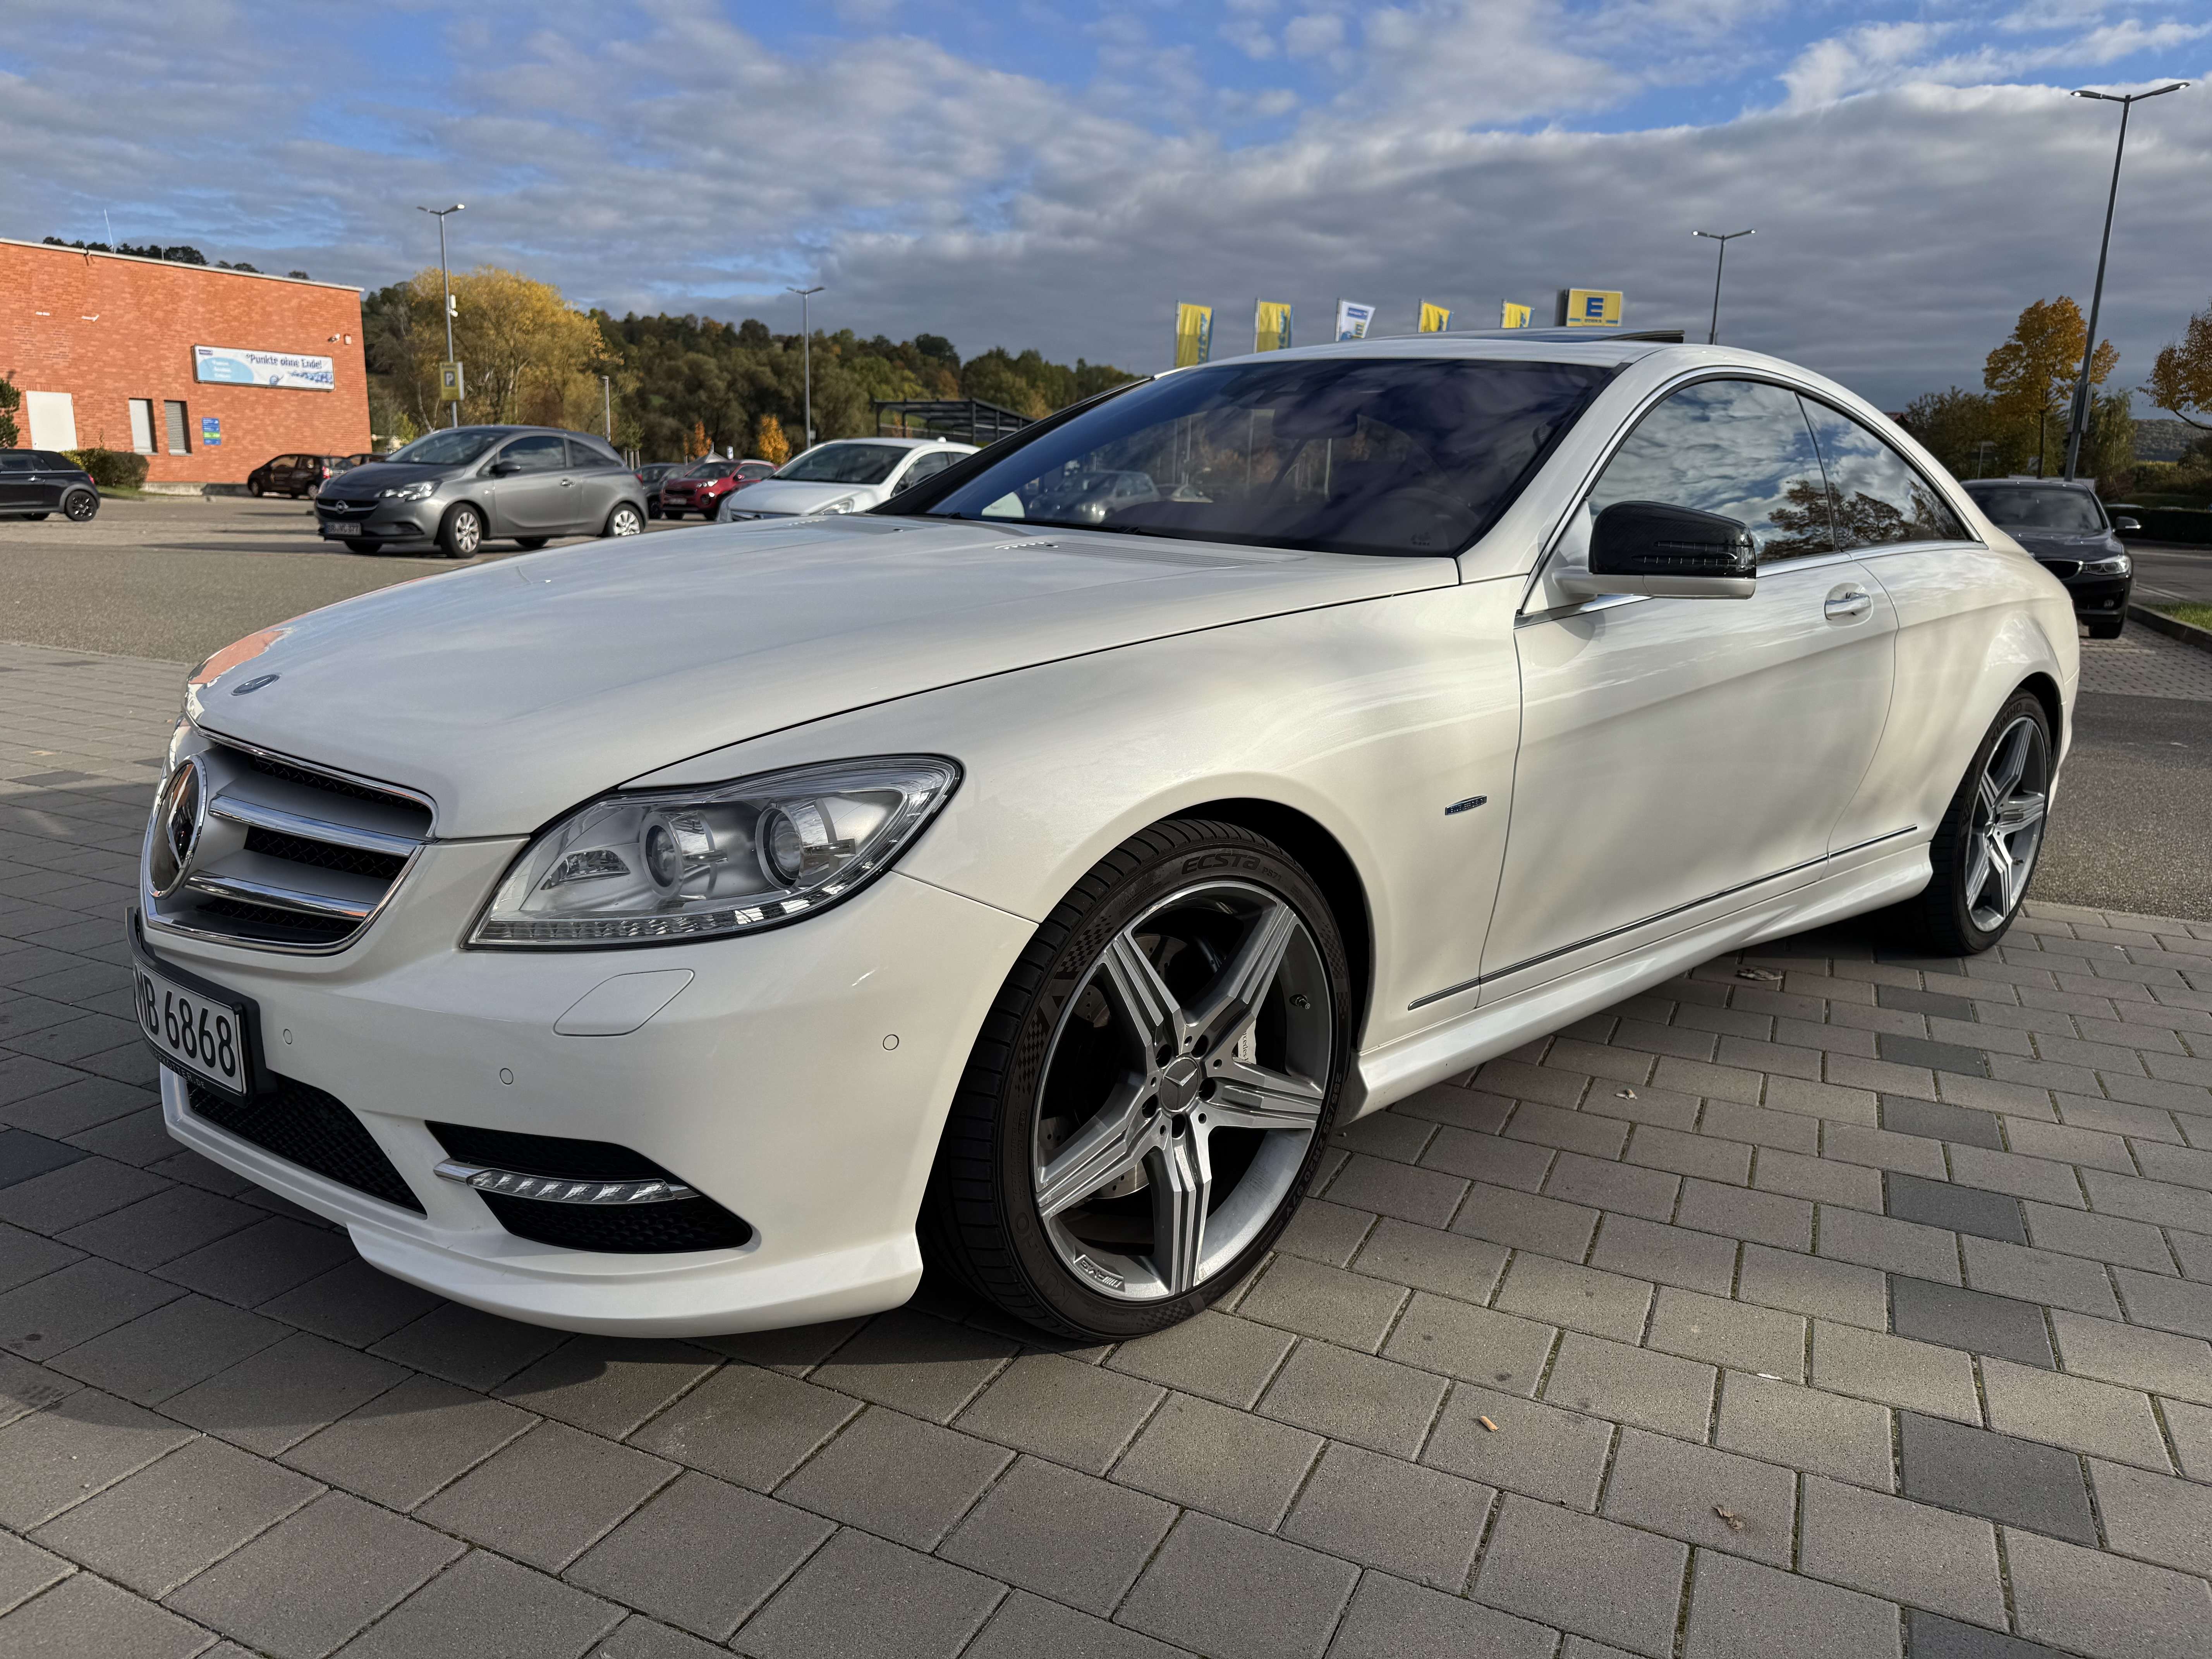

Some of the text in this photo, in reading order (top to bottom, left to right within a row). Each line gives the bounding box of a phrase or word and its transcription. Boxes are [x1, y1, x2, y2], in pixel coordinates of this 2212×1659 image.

[1586, 297, 1604, 317] E
[1262, 867, 1282, 881] PS71
[165, 990, 235, 1077] 6868
